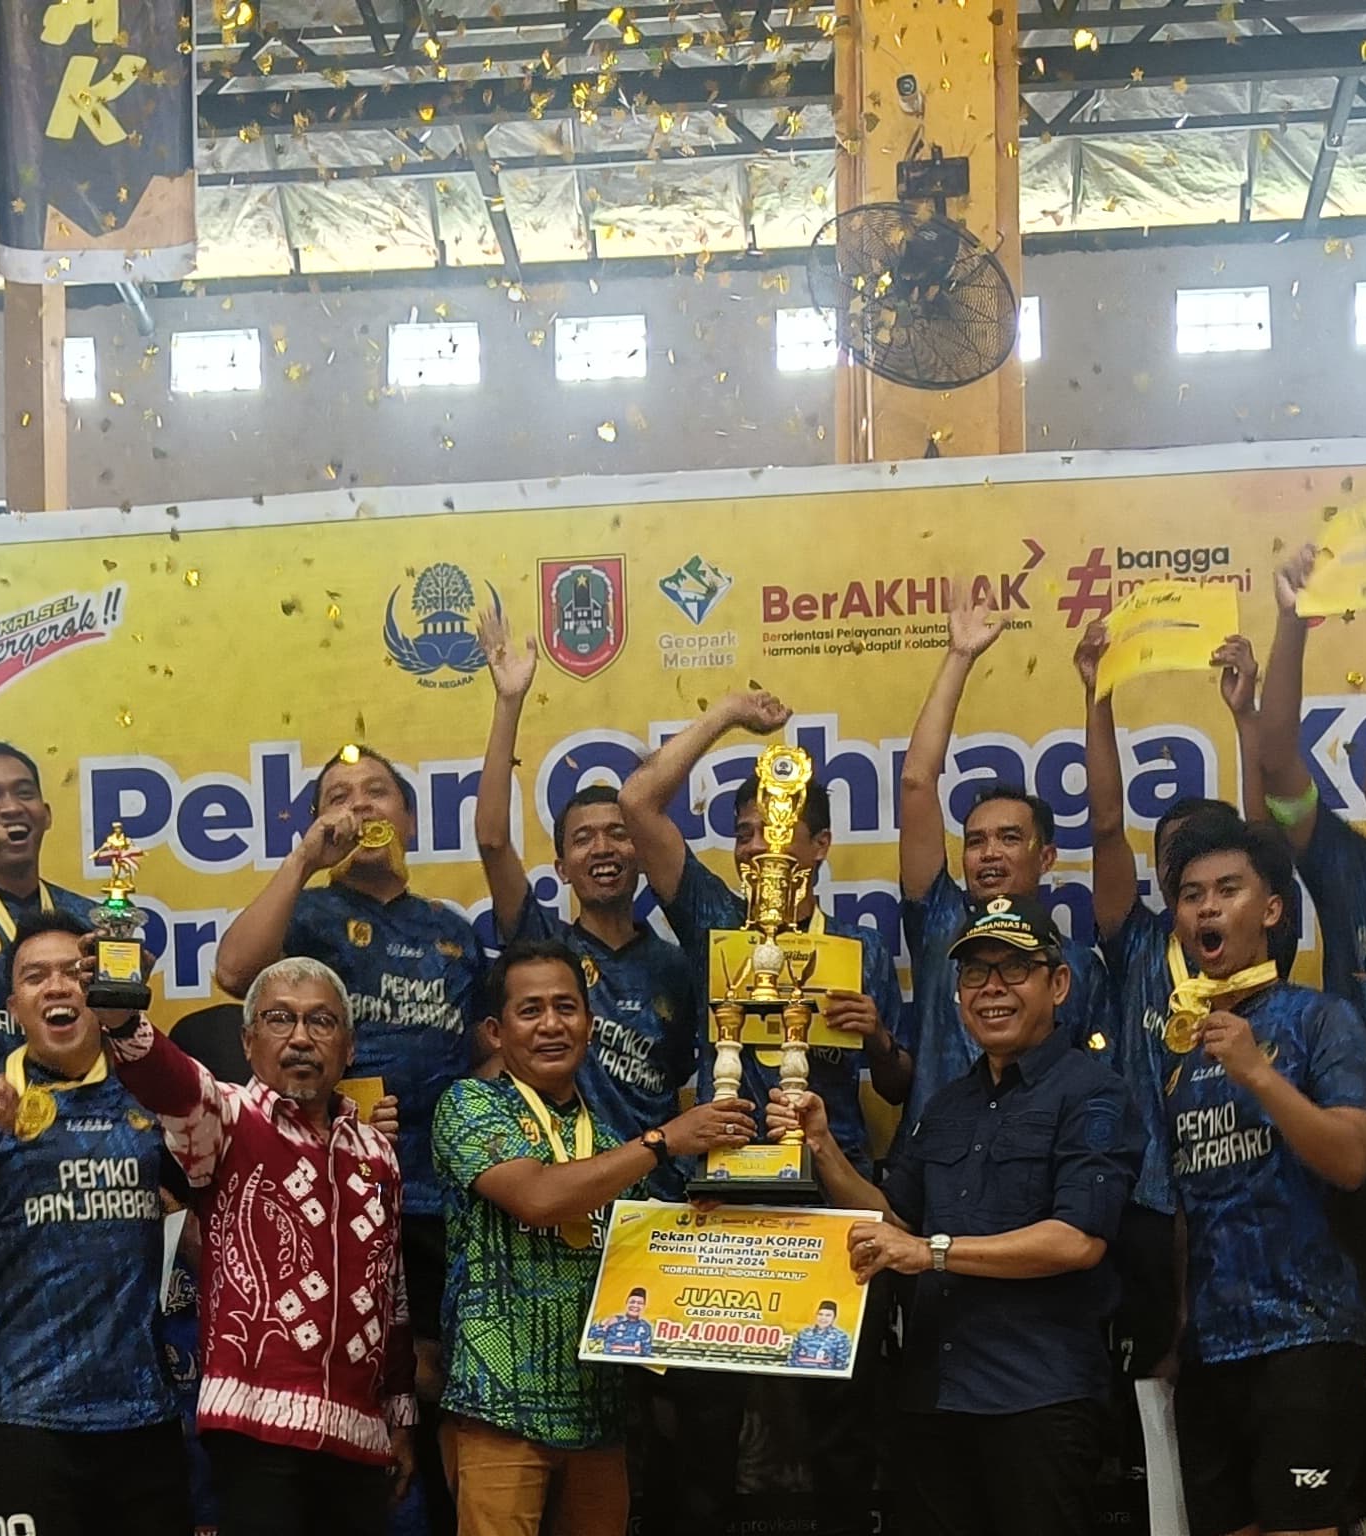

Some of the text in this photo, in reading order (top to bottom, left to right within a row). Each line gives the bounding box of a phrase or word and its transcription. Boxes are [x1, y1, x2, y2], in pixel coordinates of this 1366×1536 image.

[1117, 547, 1229, 574] bangga
[659, 632, 737, 649] Geopark
[763, 631, 833, 642] Berorientasi
[837, 627, 900, 639] Pelayanan
[439, 676, 474, 688] NEGARA
[588, 1016, 655, 1060] PEMKO
[1177, 1101, 1235, 1143] PEMKO
[58, 1157, 139, 1191] PEMKO
[651, 1231, 822, 1248] Pekan Olahraga KORPRI
[649, 1243, 819, 1259] Provinsi Kalimantan Selatan
[697, 1255, 765, 1266] Tahun 2024
[674, 1287, 762, 1311] JUARA
[686, 1308, 762, 1321] CABOR FUTSAL
[657, 1321, 684, 1340] Rp.
